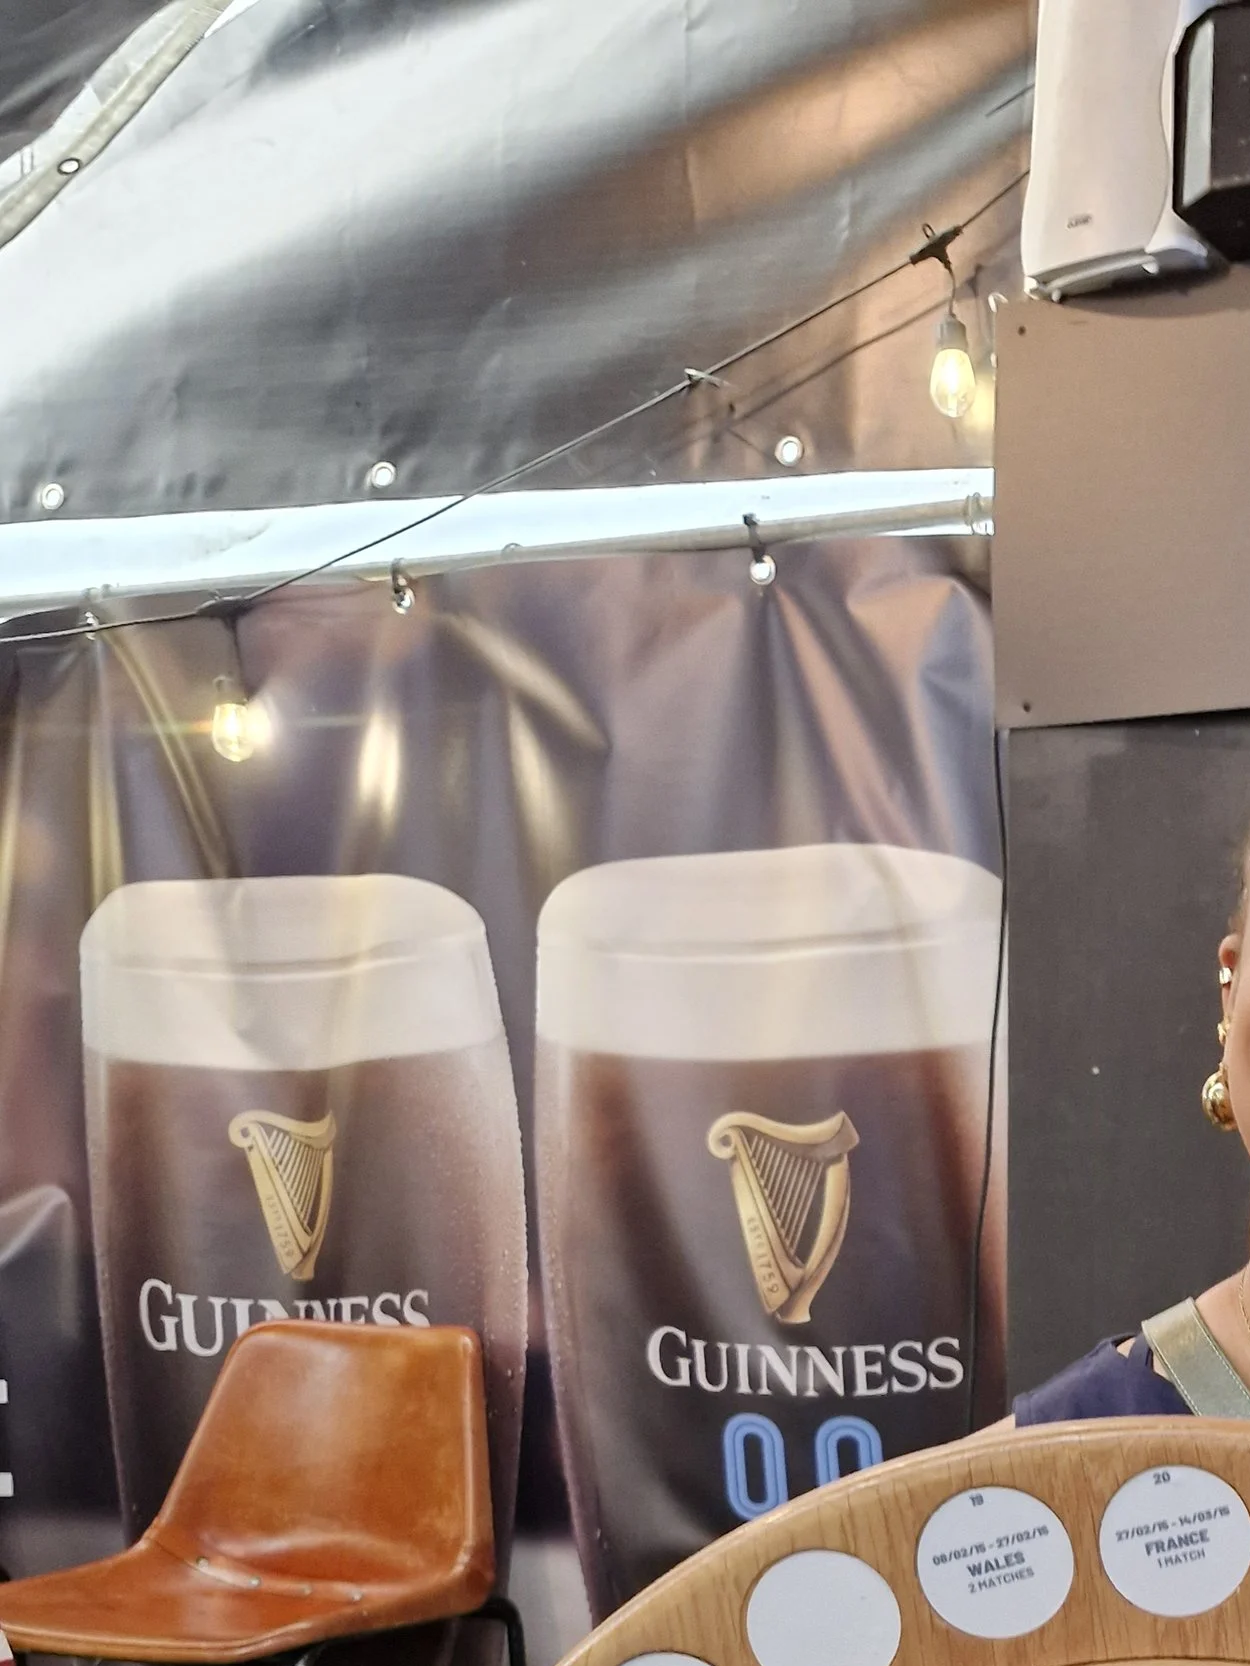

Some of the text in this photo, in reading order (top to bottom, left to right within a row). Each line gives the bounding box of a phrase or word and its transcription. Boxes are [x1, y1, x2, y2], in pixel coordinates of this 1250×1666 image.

[757, 1253, 779, 1294] 1759
[647, 1325, 964, 1397] GUINNESS
[1153, 1472, 1171, 1486] 20
[969, 1494, 984, 1507] 19
[1144, 1530, 1210, 1556] FRANCE
[967, 1552, 1026, 1578] WALES
[1164, 1550, 1206, 1567] MATCH
[978, 1568, 1034, 1590] MATCHES
